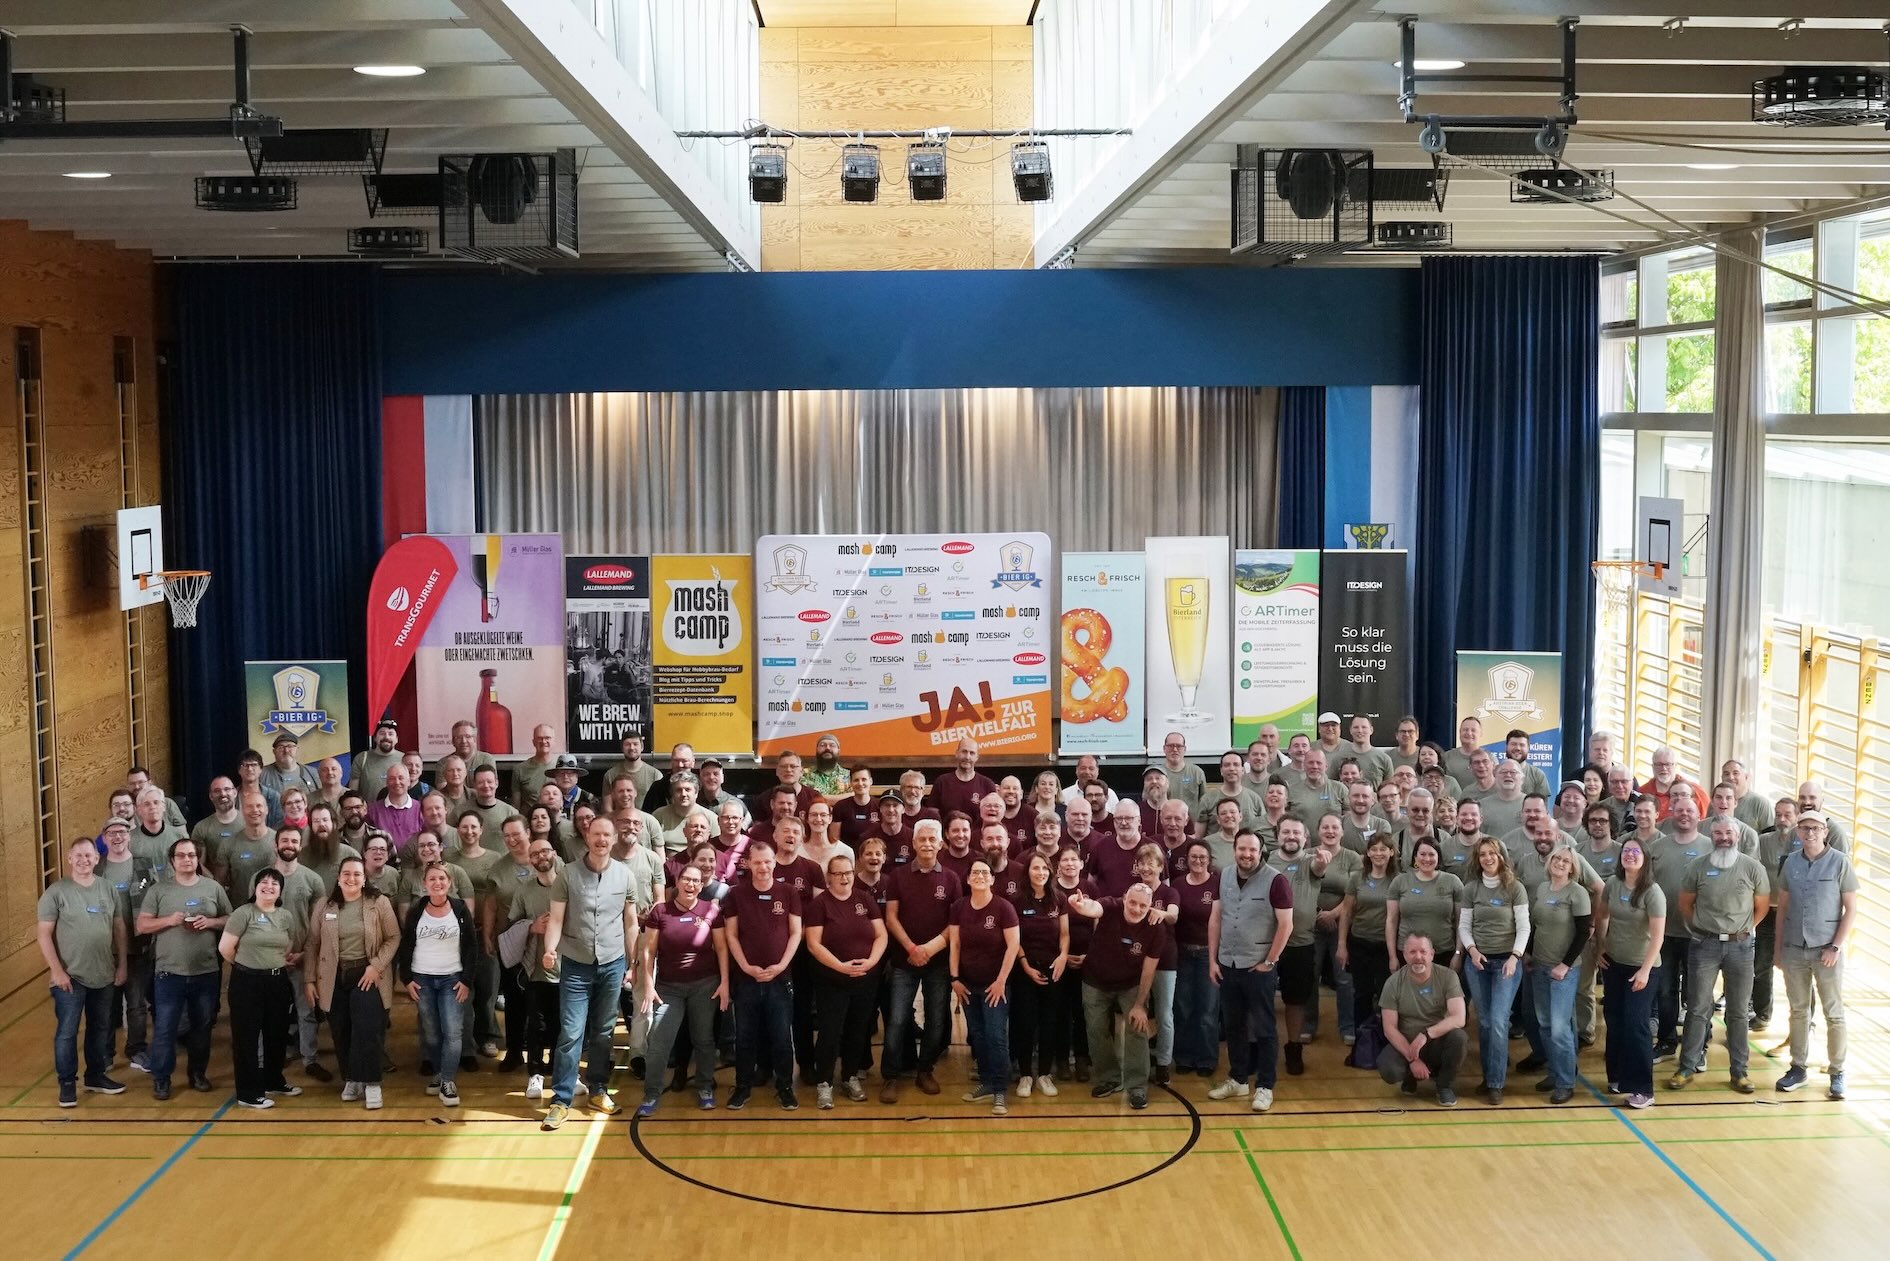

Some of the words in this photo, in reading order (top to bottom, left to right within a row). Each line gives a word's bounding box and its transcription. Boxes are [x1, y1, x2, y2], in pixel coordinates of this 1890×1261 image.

[838, 542, 860, 555] mash
[875, 544, 897, 558] camp
[586, 570, 633, 579] LALLEMAND
[1002, 573, 1020, 581] BIER
[674, 580, 729, 612] mash
[394, 568, 441, 647] TRANSGOURMET
[982, 605, 1003, 618] mash
[1019, 607, 1040, 621] camp
[1173, 608, 1202, 616] Bierland
[1254, 605, 1316, 616] ARTimer
[454, 632, 462, 645] OB
[506, 632, 523, 645] WEINE
[674, 615, 729, 649] camp
[911, 630, 933, 644] mash
[947, 632, 970, 646] camp
[1342, 626, 1358, 638] So
[1361, 626, 1386, 638] klar
[444, 648, 459, 661] ODER
[459, 648, 496, 661] EINGEMACHTE
[496, 647, 535, 661] ZWETSCHKEN.
[1334, 643, 1370, 653] muss
[1371, 641, 1393, 653] die
[1339, 656, 1387, 670] Lösung
[1347, 672, 1377, 683] sein.
[578, 703, 600, 721] WE
[602, 703, 641, 721] BREW
[768, 699, 790, 712] mash
[804, 701, 827, 715] camp
[911, 680, 996, 732] JA!
[1001, 700, 1034, 718] ZUR
[278, 712, 304, 722] BIER
[307, 712, 318, 722] IG
[578, 722, 613, 741] WITH
[930, 713, 1037, 746] BIERVIELFALT
[1529, 742, 1553, 751] KÜREN
